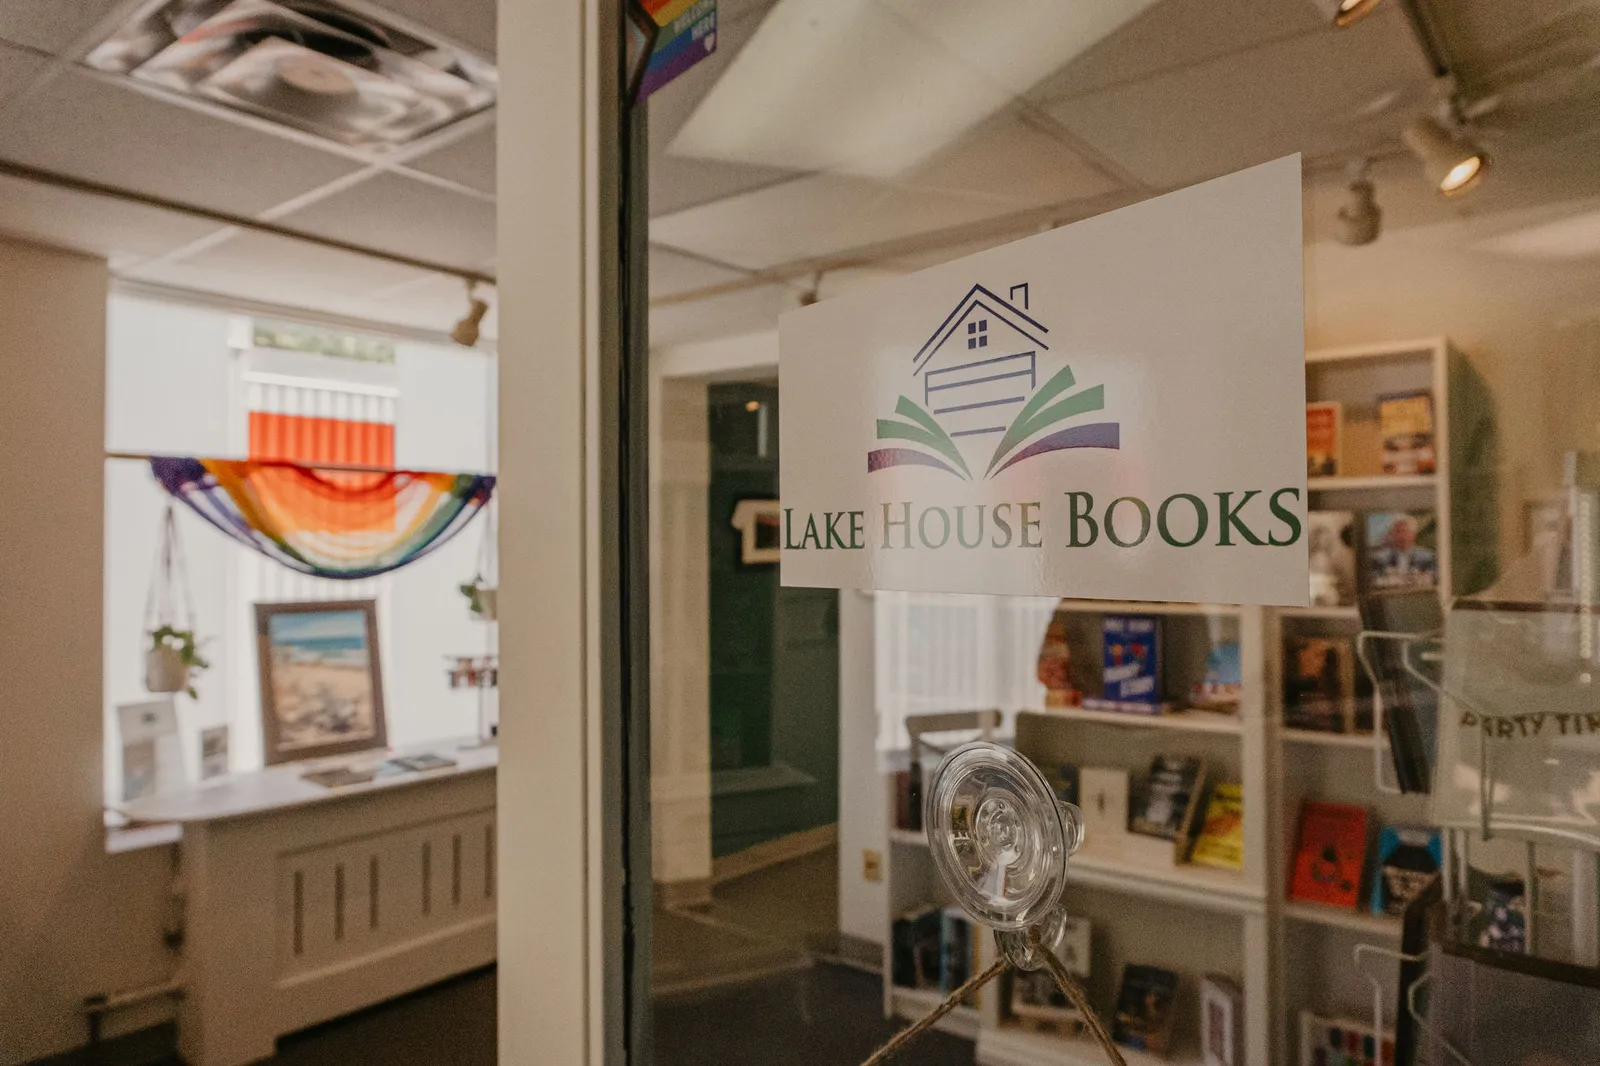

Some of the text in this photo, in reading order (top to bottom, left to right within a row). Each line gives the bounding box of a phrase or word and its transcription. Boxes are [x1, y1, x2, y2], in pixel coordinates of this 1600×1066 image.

[784, 488, 1302, 549] LAKE HOUSE BOOKS
